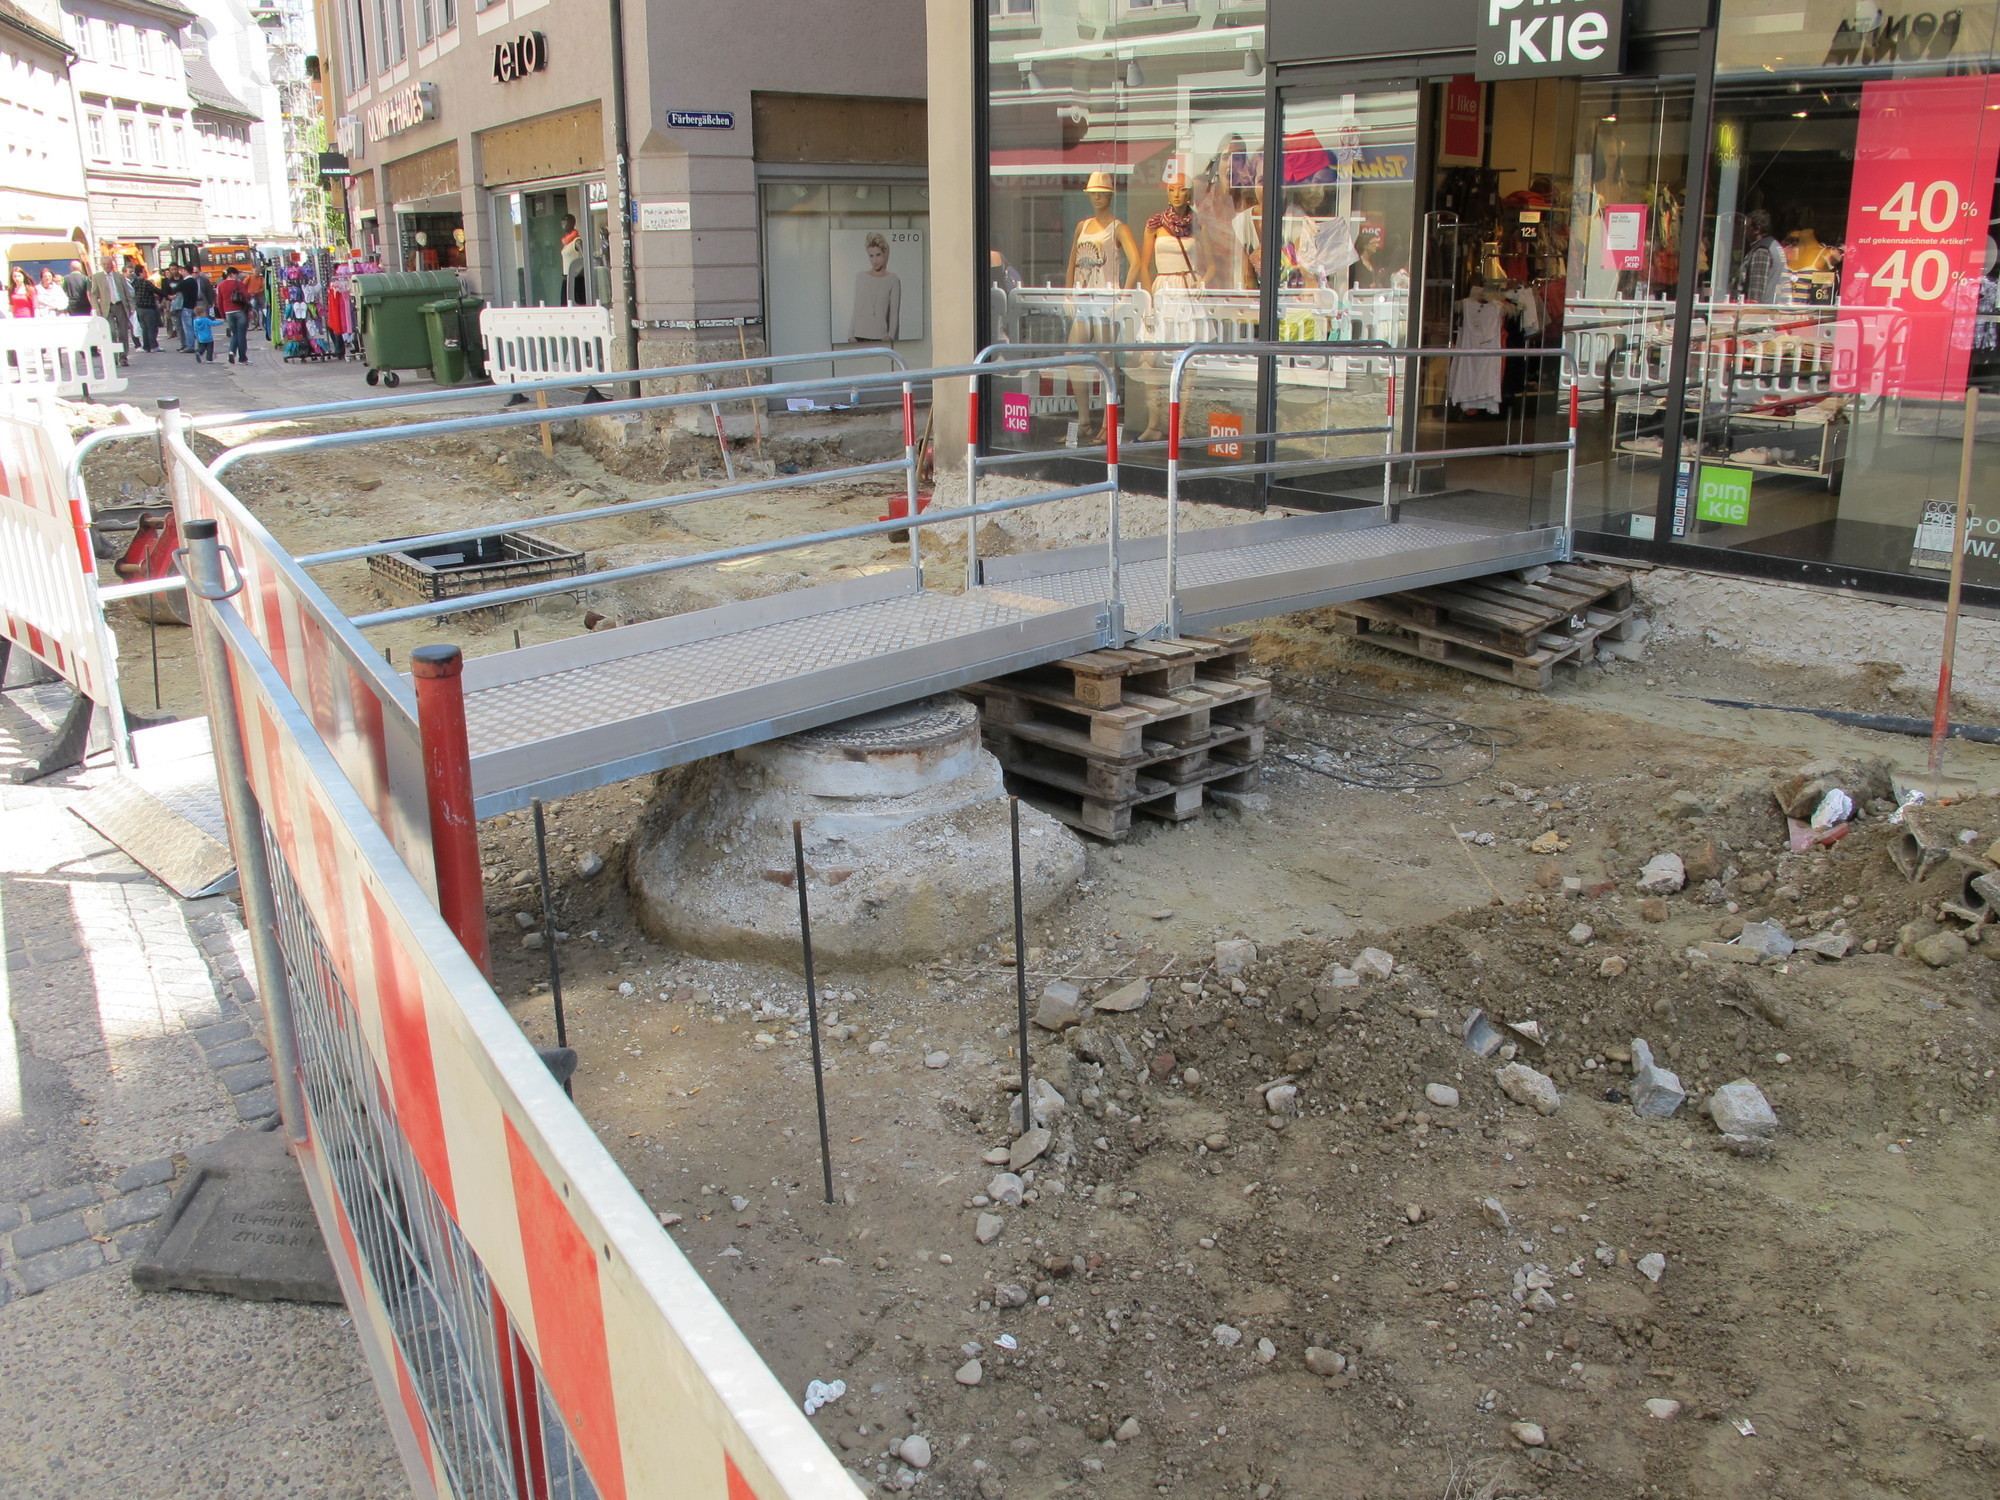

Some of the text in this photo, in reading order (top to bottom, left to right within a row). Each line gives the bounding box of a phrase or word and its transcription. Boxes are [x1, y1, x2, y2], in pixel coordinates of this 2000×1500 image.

[491, 30, 542, 84] zero
[671, 113, 730, 127] Färbergäßchen
[892, 233, 920, 242] zero
[1872, 237, 1938, 245] gekennzeichnete
[1004, 404, 1027, 418] pim
[1702, 482, 1747, 503] pim
